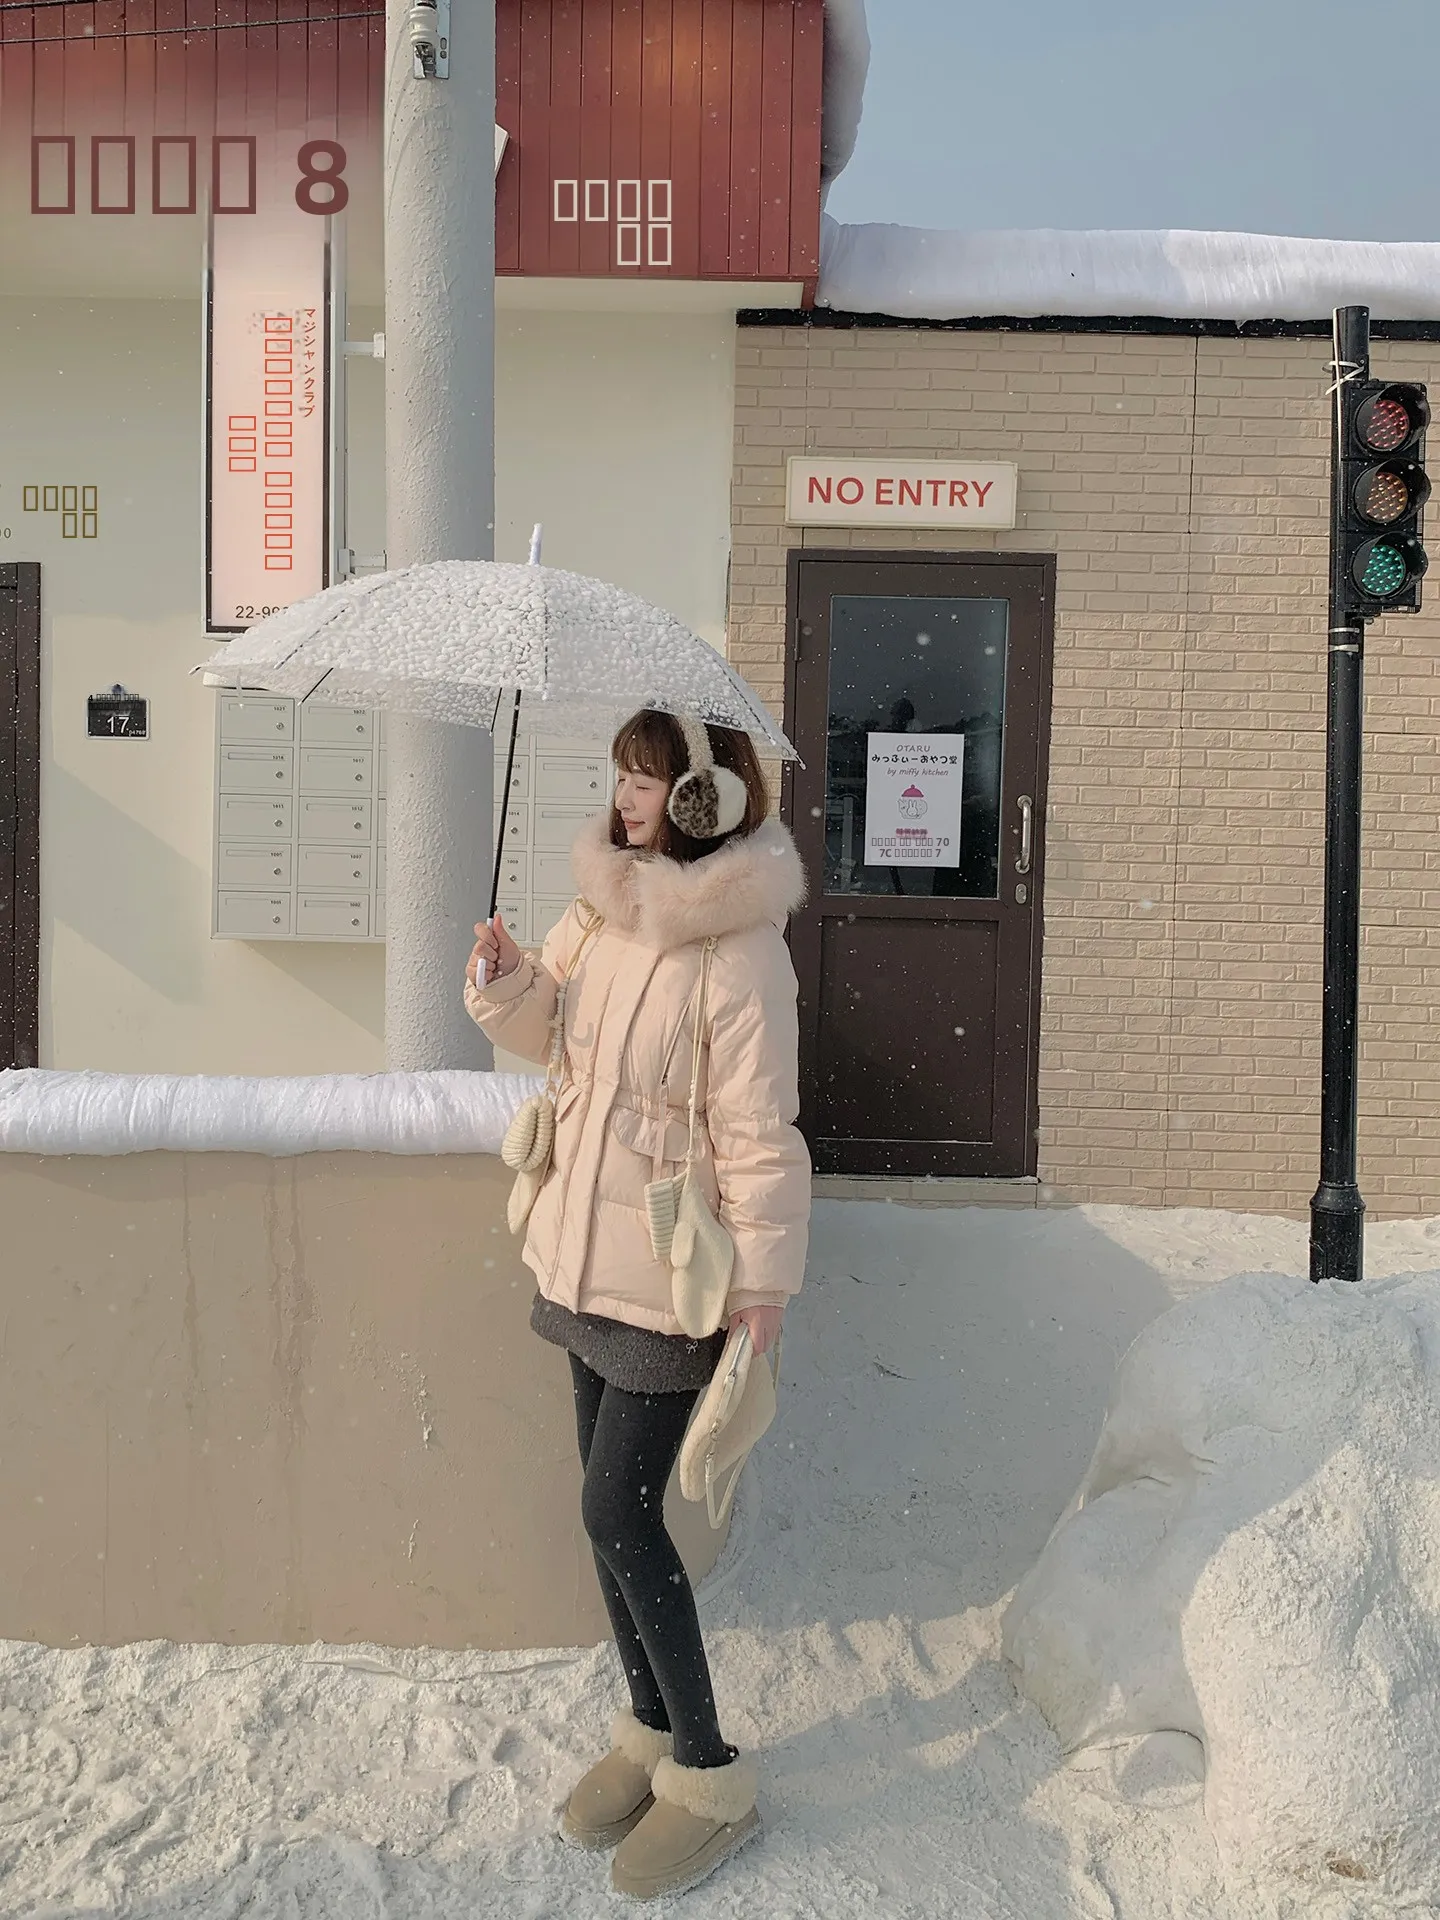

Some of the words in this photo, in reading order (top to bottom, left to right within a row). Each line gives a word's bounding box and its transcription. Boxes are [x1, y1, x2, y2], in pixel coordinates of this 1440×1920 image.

[808, 476, 865, 505] NO
[875, 478, 994, 508] ENTRY
[107, 716, 130, 734] 17
[896, 744, 931, 753] OTARU
[887, 768, 897, 776] by
[899, 768, 919, 777] miffy
[921, 768, 949, 776] kitchen
